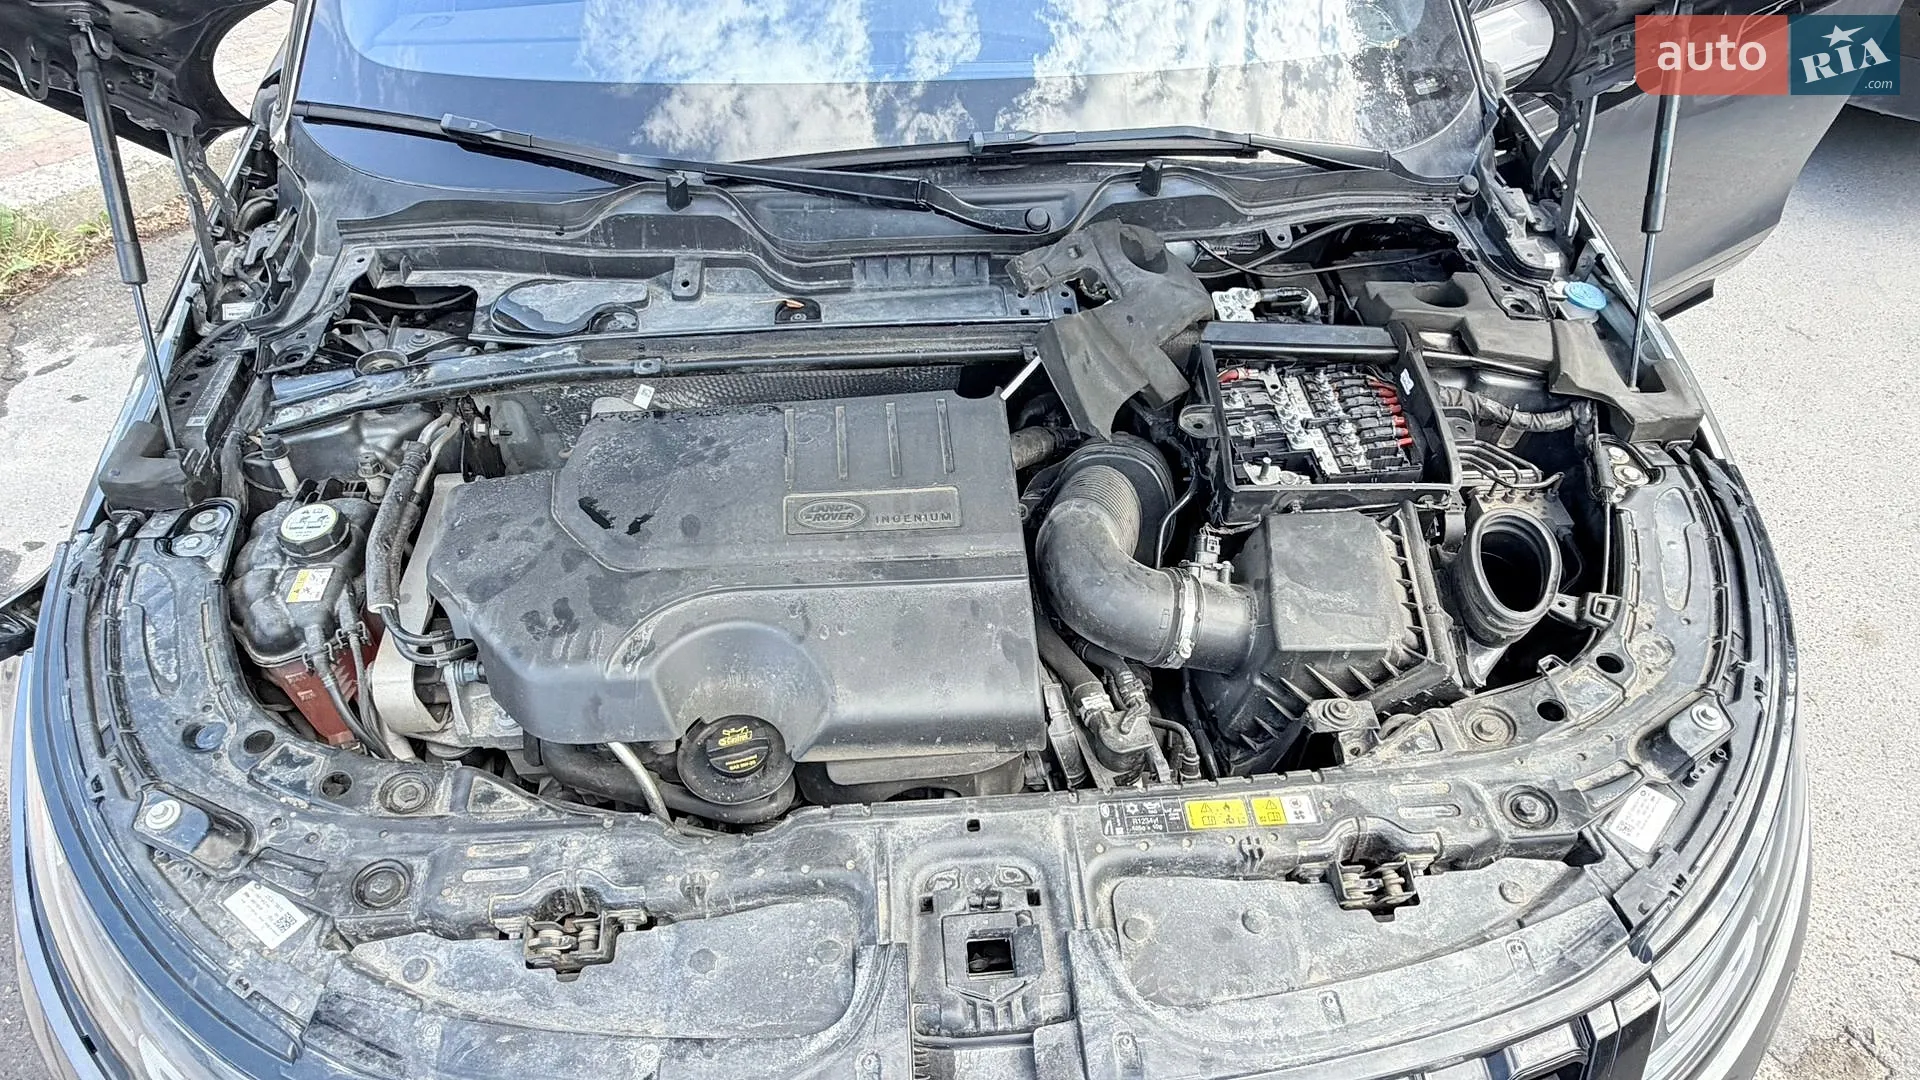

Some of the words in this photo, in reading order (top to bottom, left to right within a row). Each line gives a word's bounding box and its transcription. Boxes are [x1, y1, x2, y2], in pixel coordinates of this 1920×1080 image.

[810, 504, 845, 513] LAND
[811, 512, 855, 522] ROVER
[875, 513, 952, 525] INGENIUM
